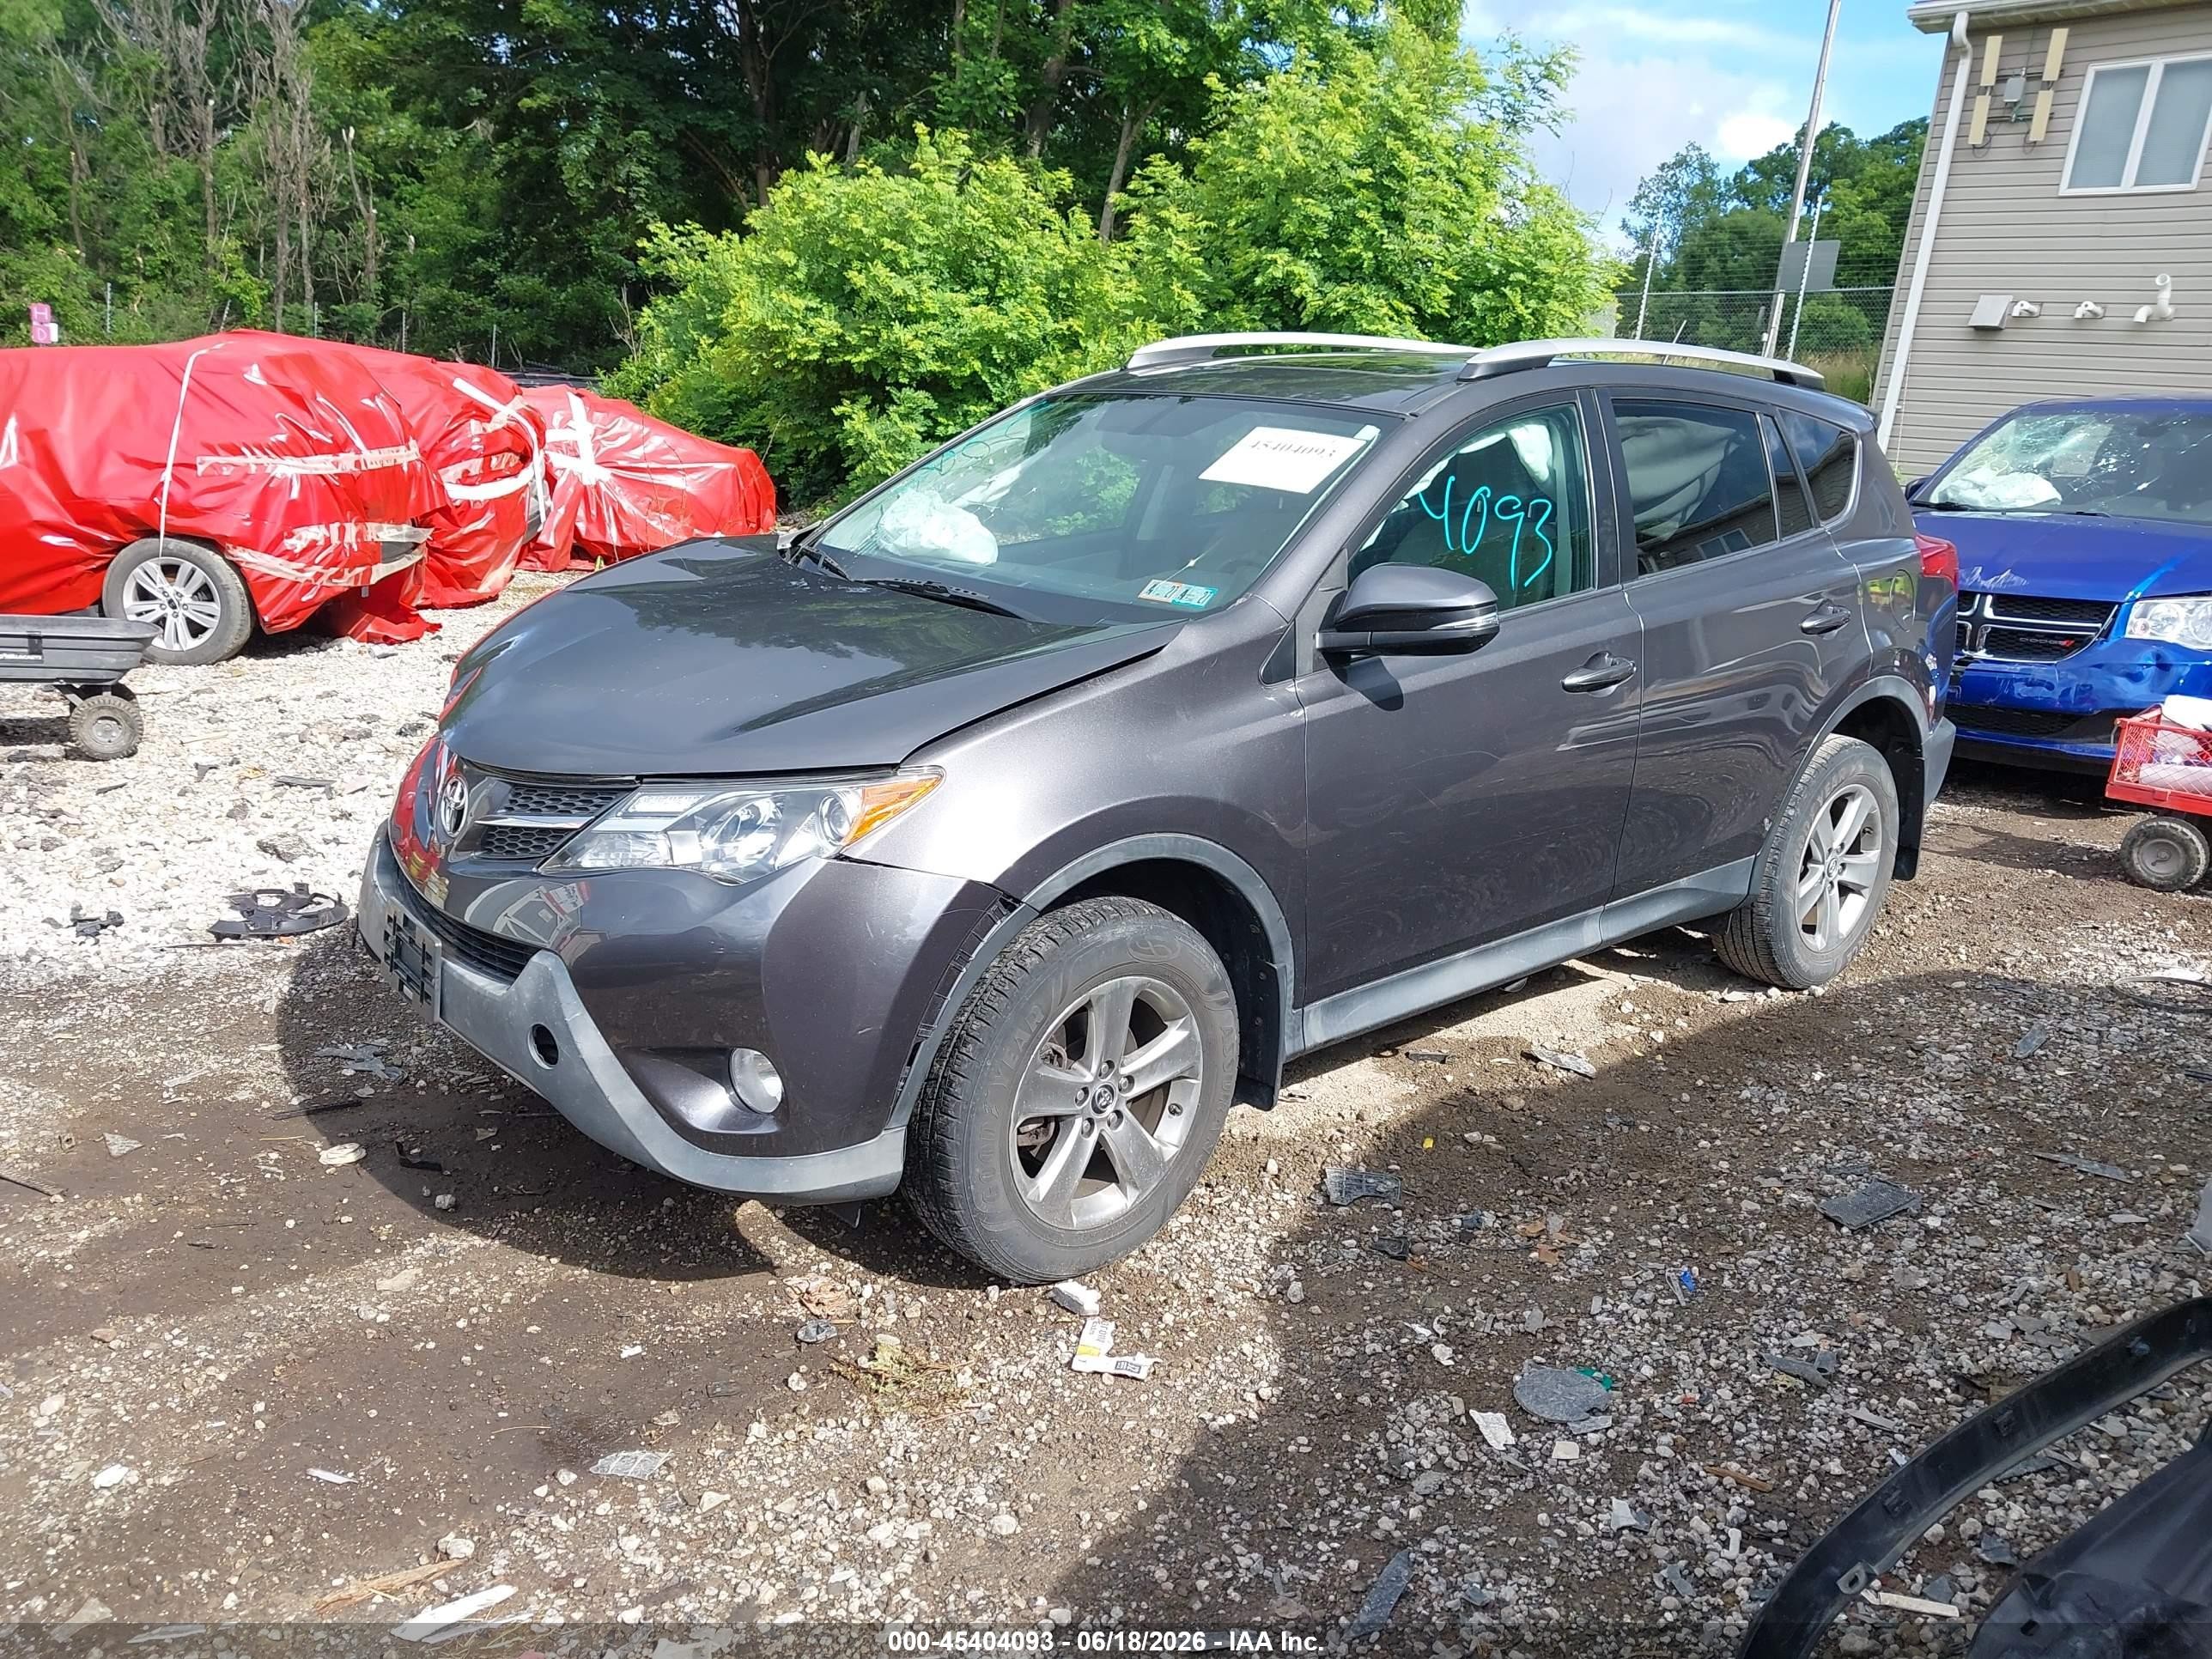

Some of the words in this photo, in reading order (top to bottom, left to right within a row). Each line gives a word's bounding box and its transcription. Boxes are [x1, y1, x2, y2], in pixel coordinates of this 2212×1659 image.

[1419, 475, 1553, 591] 4093
[2019, 637, 2065, 647] DODGE
[976, 1003, 1045, 1206] GOODYEAR
